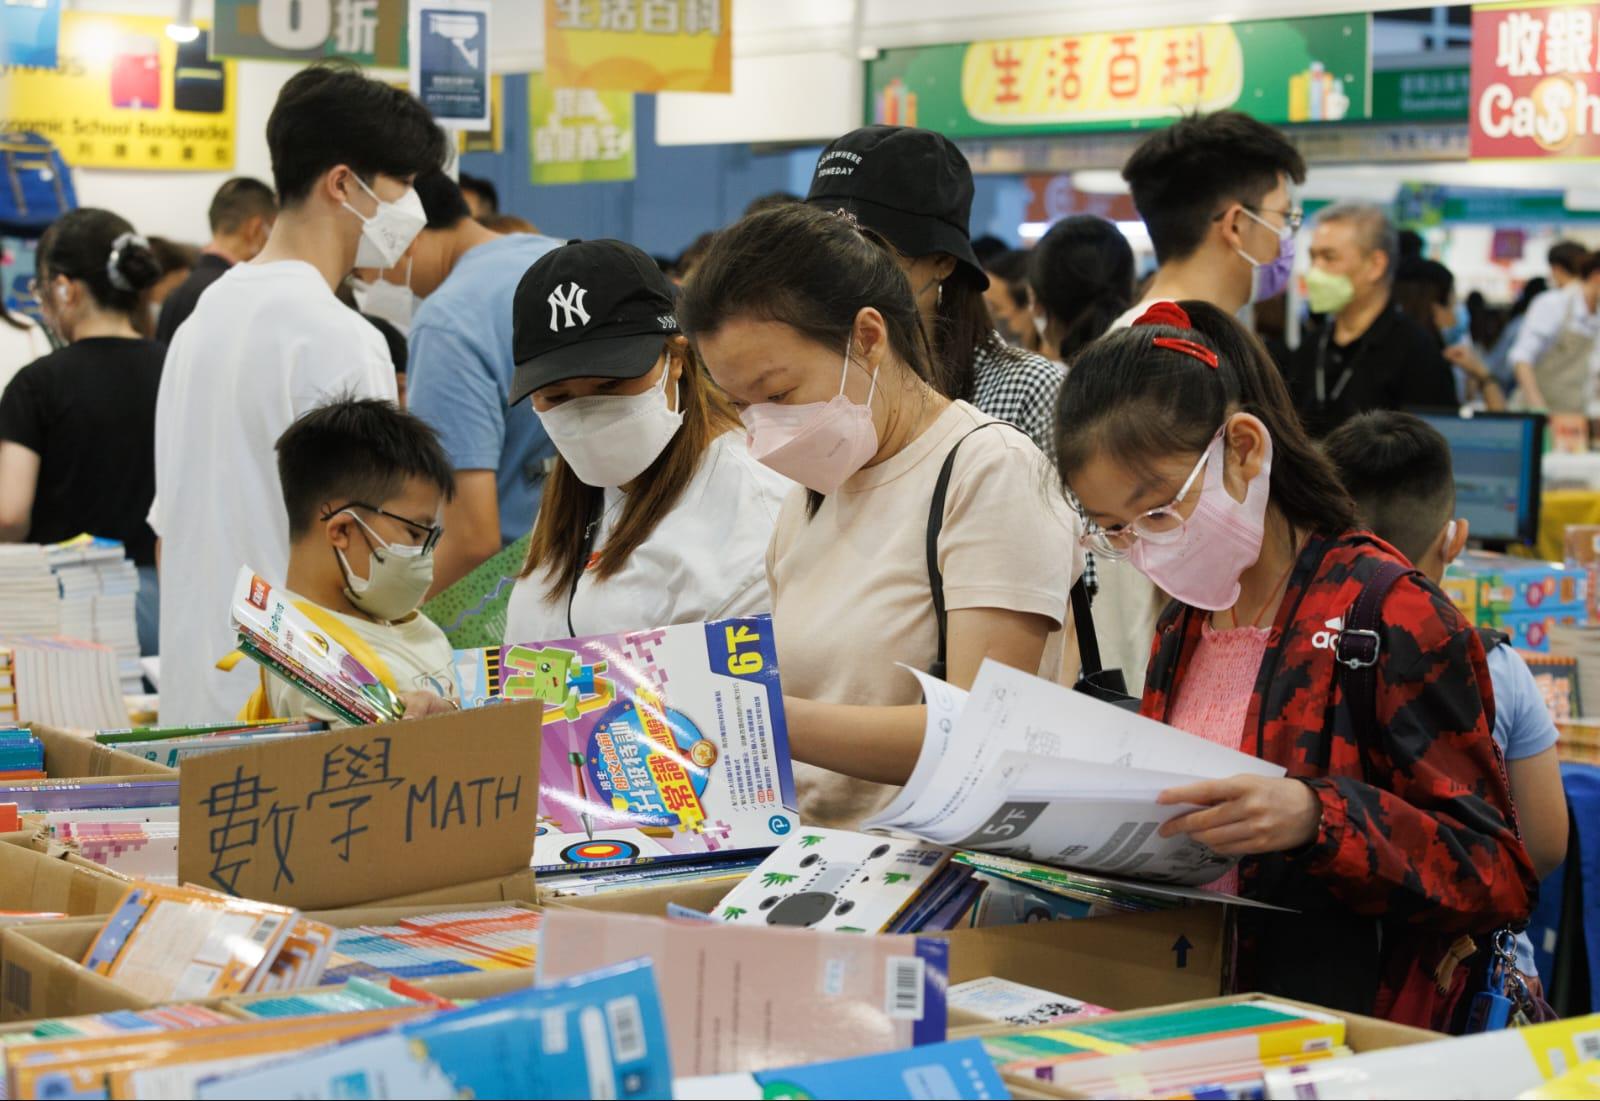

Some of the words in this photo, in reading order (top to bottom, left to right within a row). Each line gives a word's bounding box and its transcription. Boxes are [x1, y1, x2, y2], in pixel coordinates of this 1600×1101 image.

[992, 31, 1210, 104] 生活百科
[1495, 11, 1600, 77] 收銀
[817, 151, 863, 168] SOMEWHERE
[818, 167, 855, 178] SOMEDAY
[547, 281, 592, 332] NY
[725, 624, 764, 676] 6下
[595, 732, 631, 790] 朗文試前
[608, 720, 664, 813] 升級特訓
[199, 737, 406, 899] 數學
[405, 775, 521, 843] MATH
[983, 807, 1028, 836] 5下
